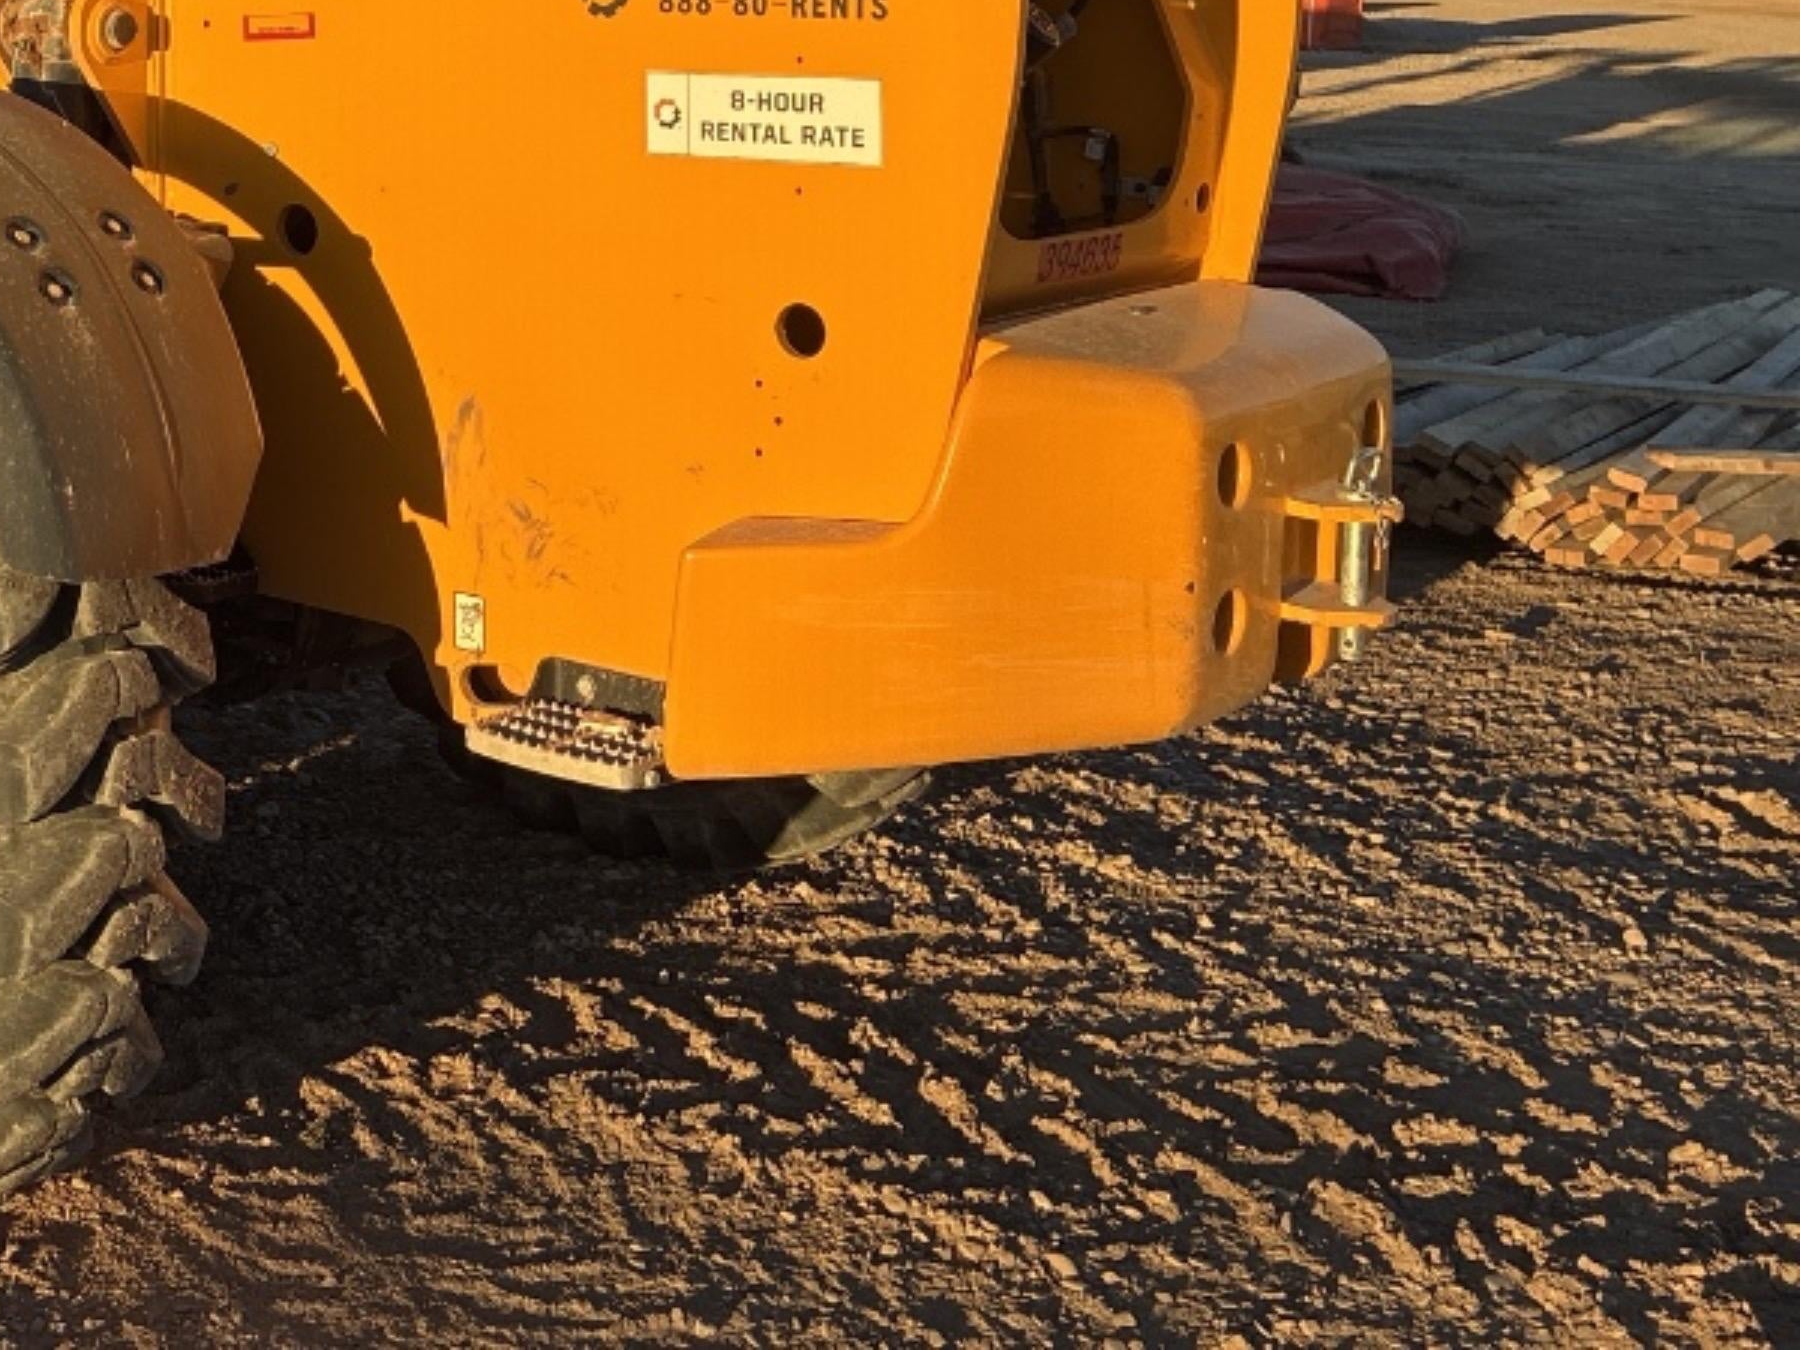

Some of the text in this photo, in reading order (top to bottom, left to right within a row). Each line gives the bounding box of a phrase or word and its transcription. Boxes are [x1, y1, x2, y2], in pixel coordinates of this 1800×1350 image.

[730, 89, 825, 114] 8-HOUR
[700, 120, 866, 149] RENTAL RATE
